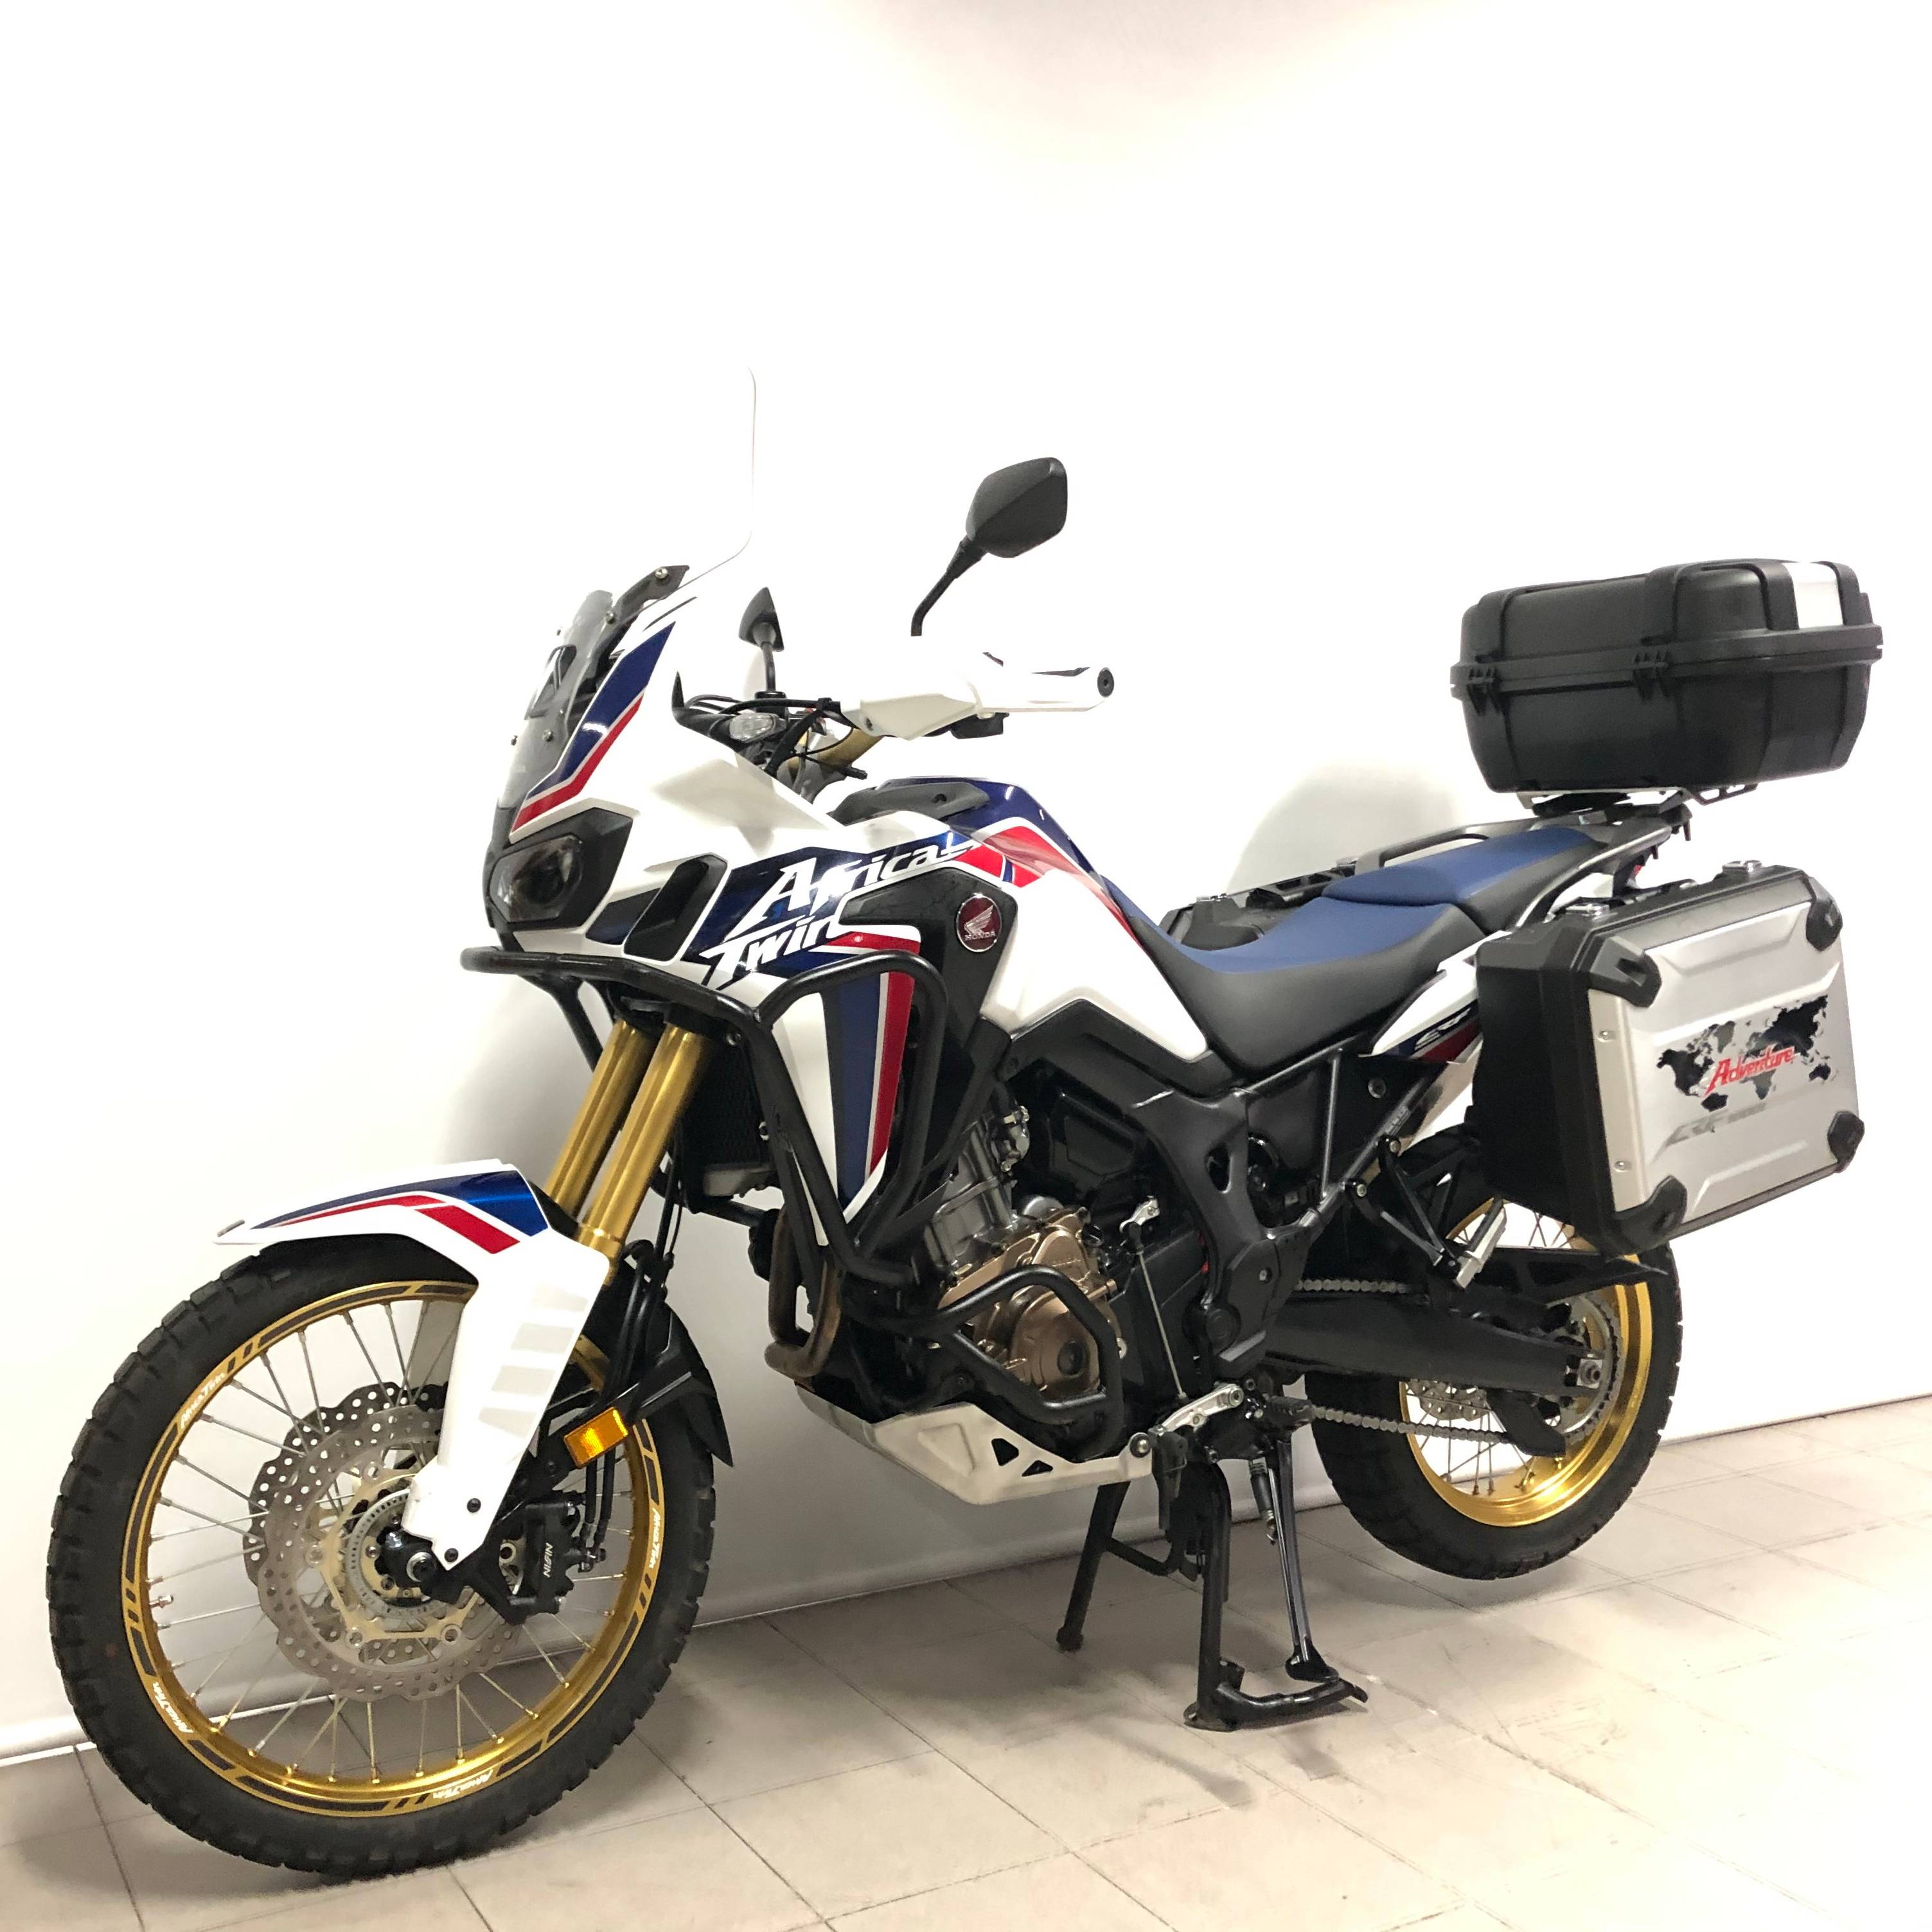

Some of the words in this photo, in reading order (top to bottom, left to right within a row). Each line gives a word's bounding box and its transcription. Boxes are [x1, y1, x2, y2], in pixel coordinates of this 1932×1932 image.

[698, 910, 843, 990] Twin
[964, 930, 997, 941] HONDA
[1705, 1045, 1796, 1096] Adventure
